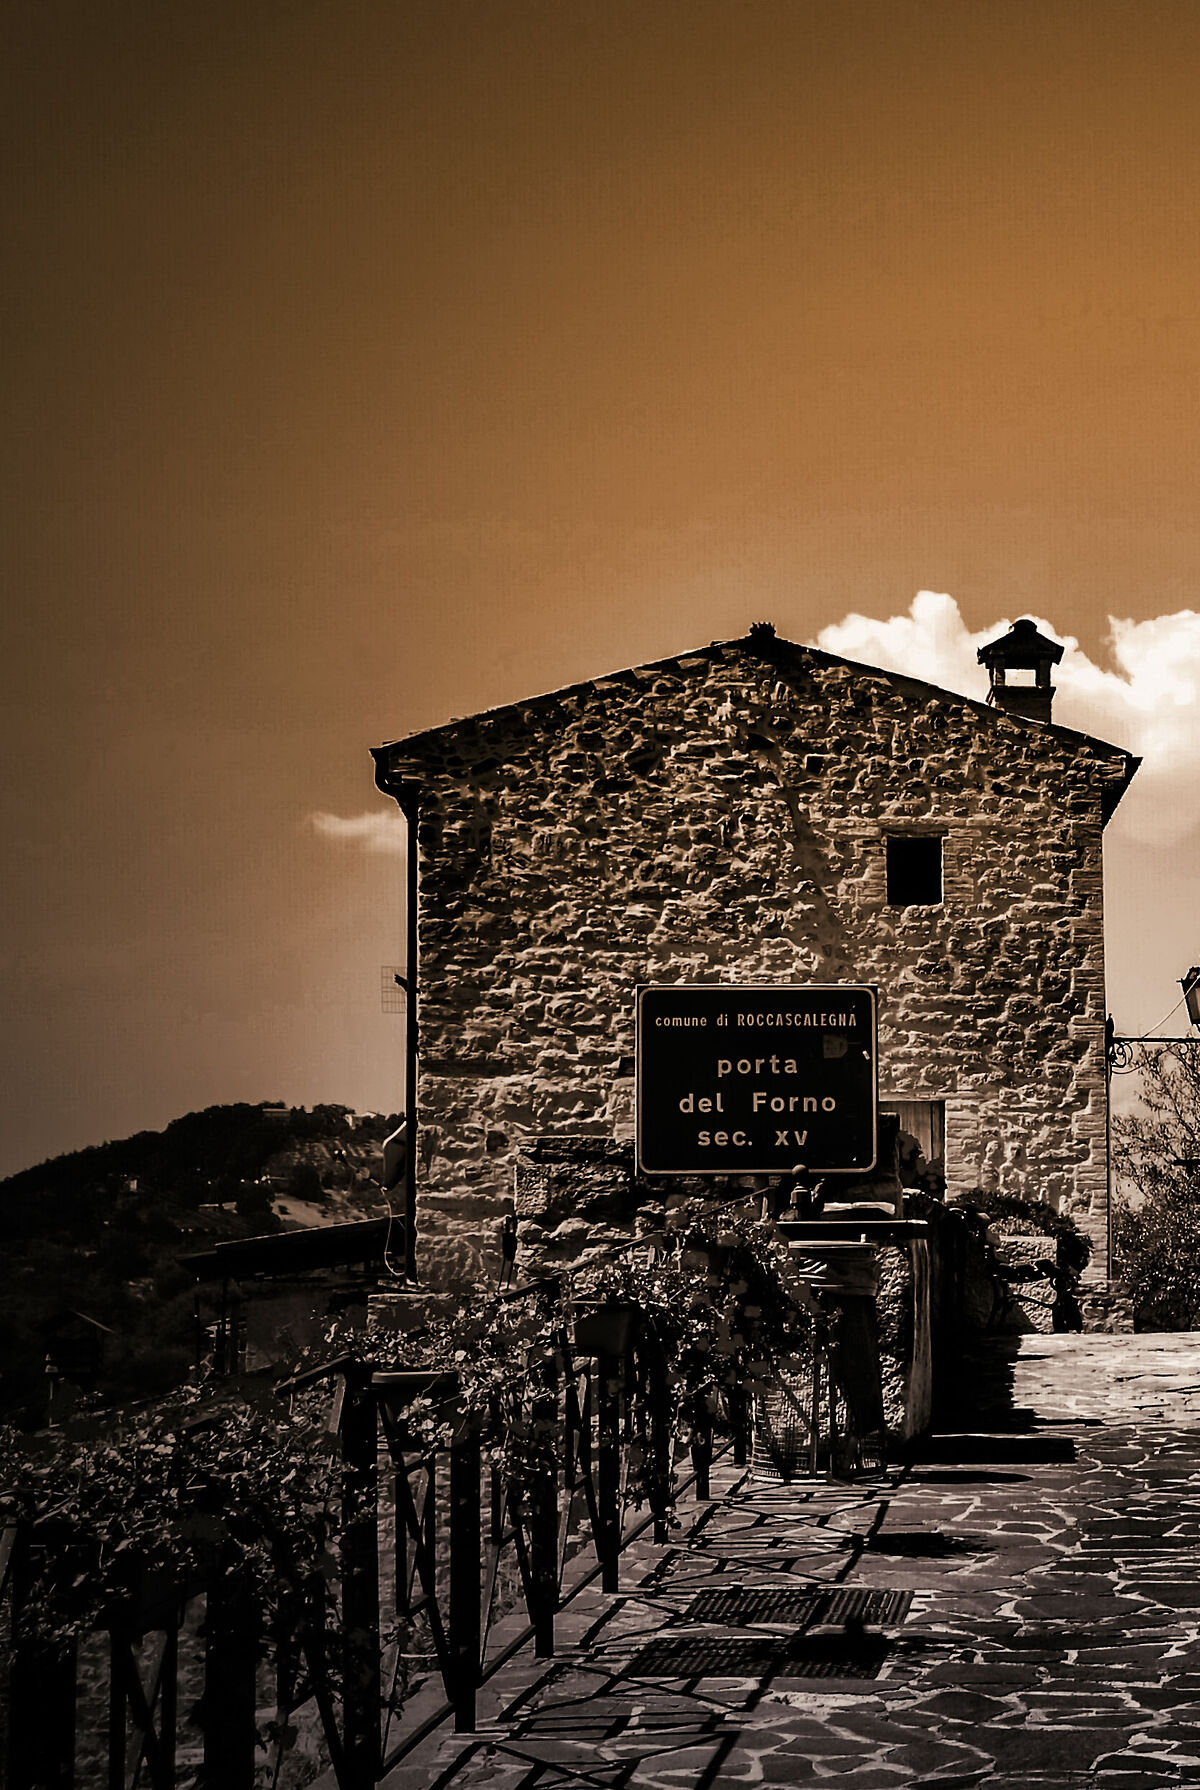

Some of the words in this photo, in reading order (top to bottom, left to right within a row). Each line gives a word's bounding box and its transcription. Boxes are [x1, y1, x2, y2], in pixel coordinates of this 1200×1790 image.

[655, 1015, 707, 1027] comune
[716, 1014, 728, 1027] di
[737, 1013, 857, 1027] ROCCASCALEGNA
[717, 1054, 798, 1078] porta
[678, 1092, 725, 1114] del
[752, 1091, 836, 1113] Forno
[697, 1130, 753, 1147] sec.
